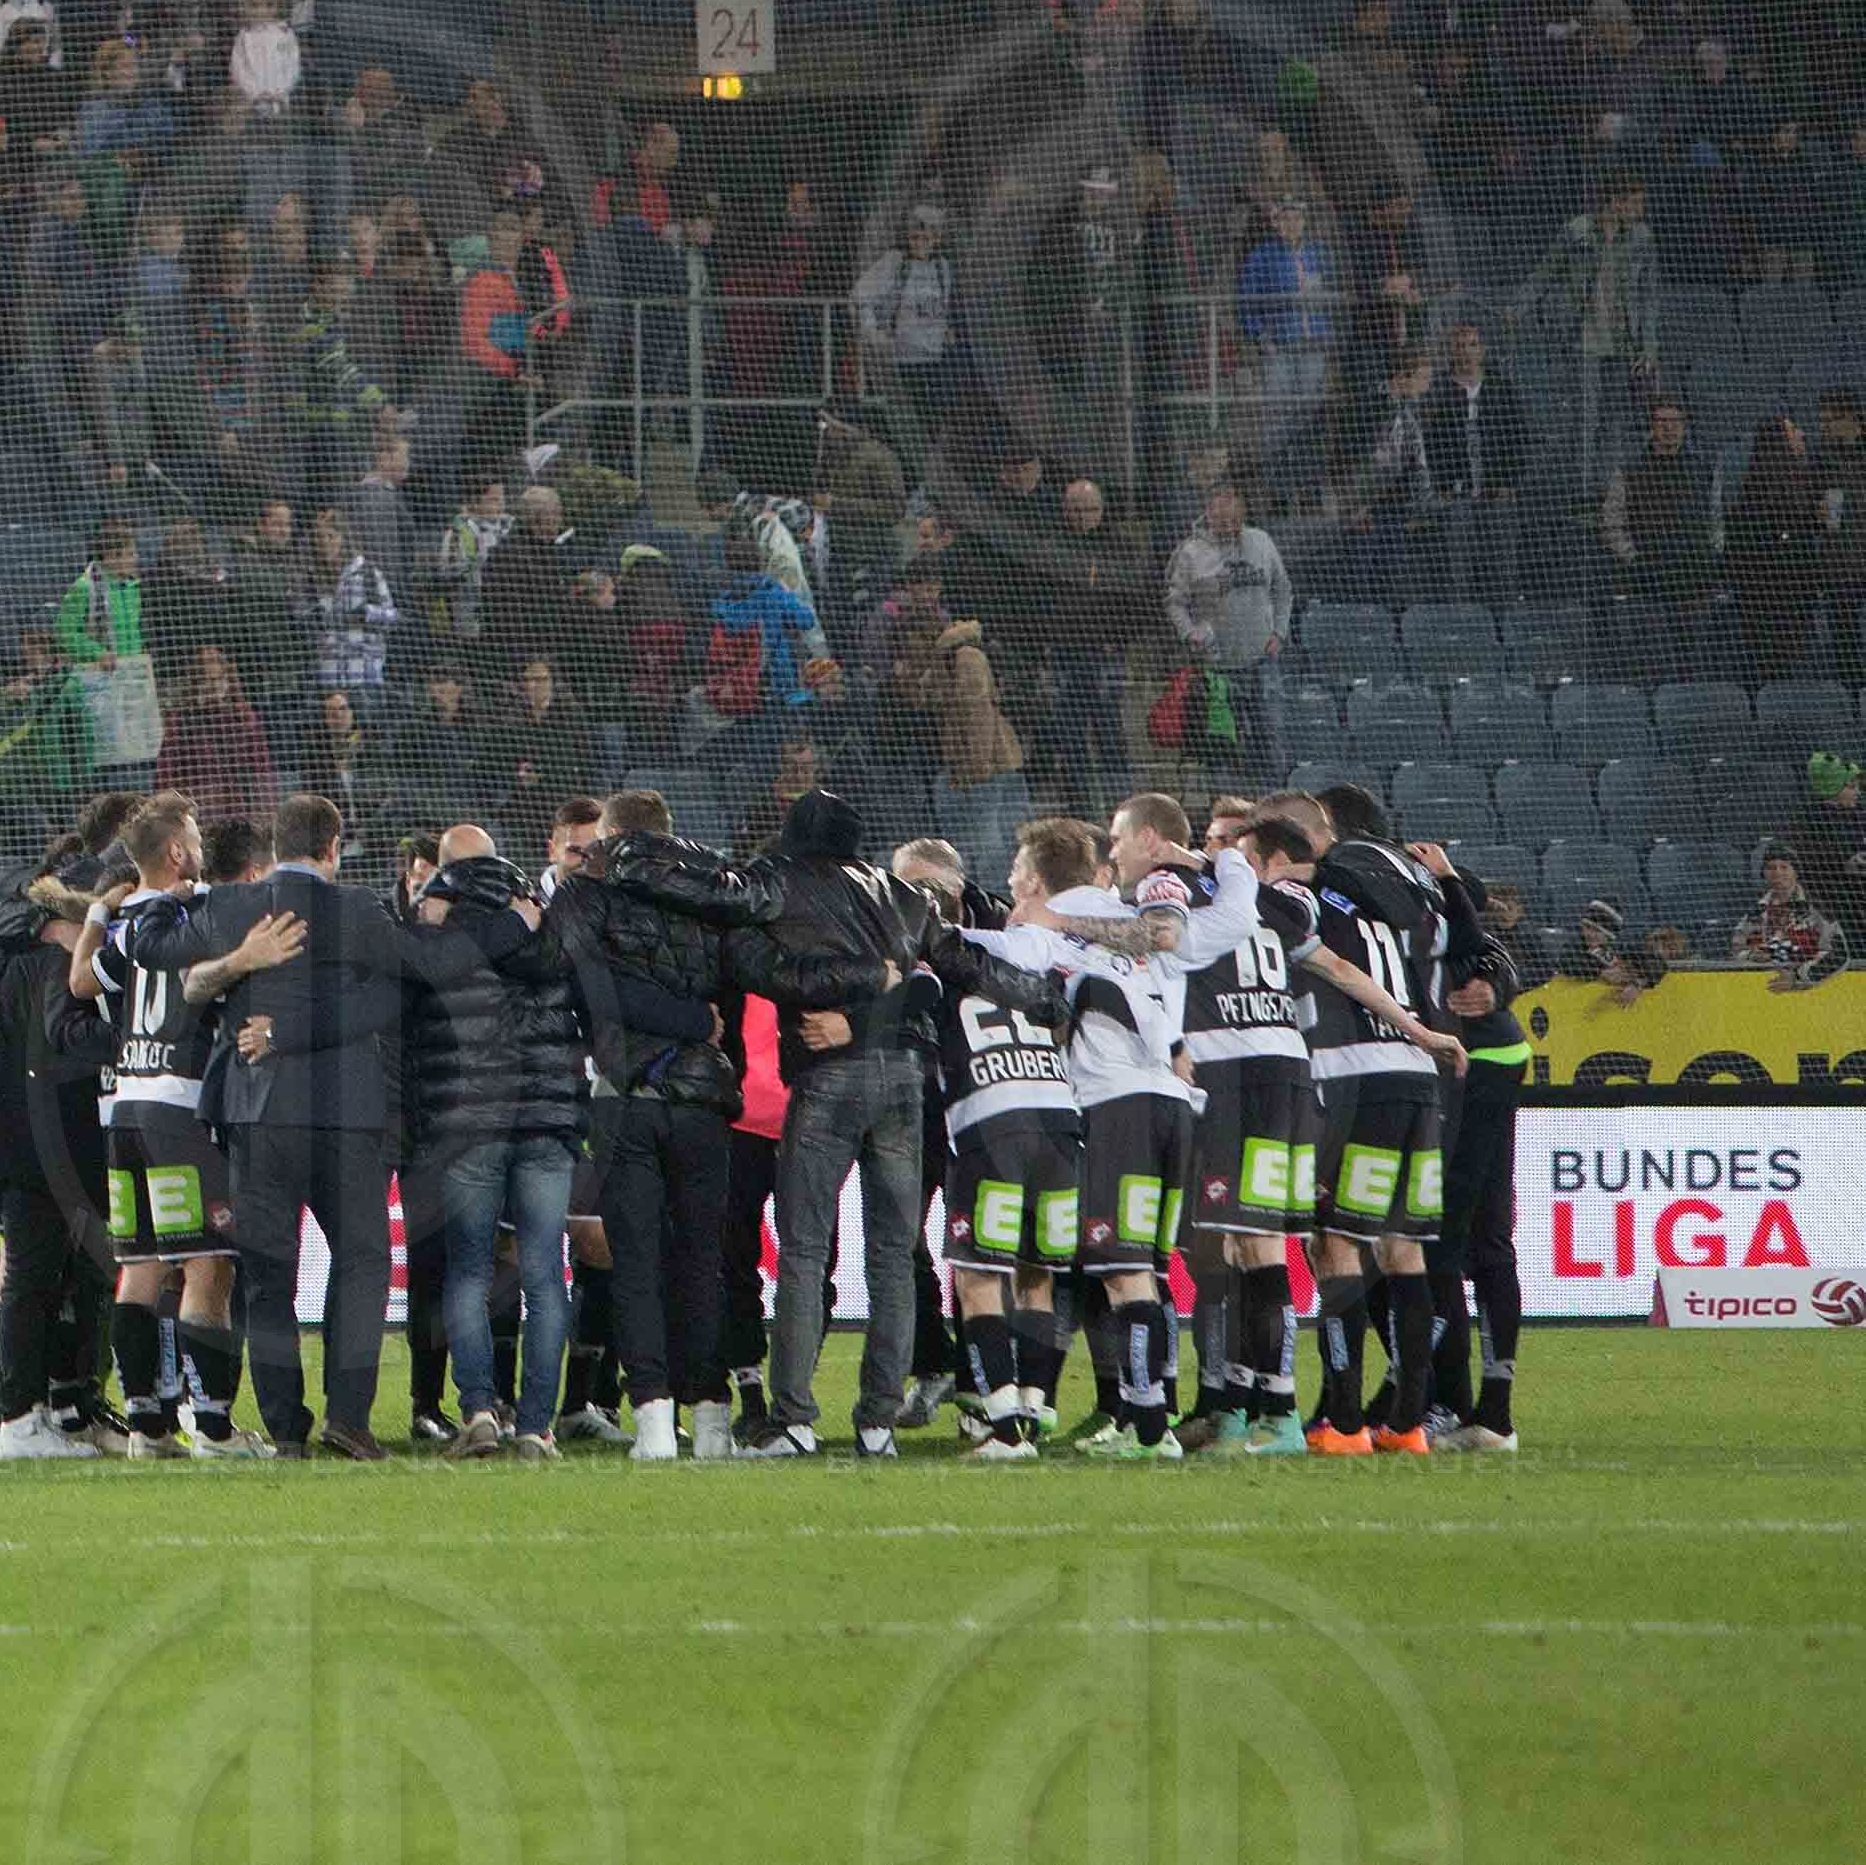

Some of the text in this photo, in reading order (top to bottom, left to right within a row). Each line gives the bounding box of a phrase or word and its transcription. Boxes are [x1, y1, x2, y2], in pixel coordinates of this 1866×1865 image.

[711, 8, 760, 58] 24
[970, 1050, 1067, 1086] GRUBER
[1552, 1149, 1802, 1192] BUNDES
[1552, 1199, 1811, 1278] LIGA
[1685, 1291, 1797, 1320] tipico
